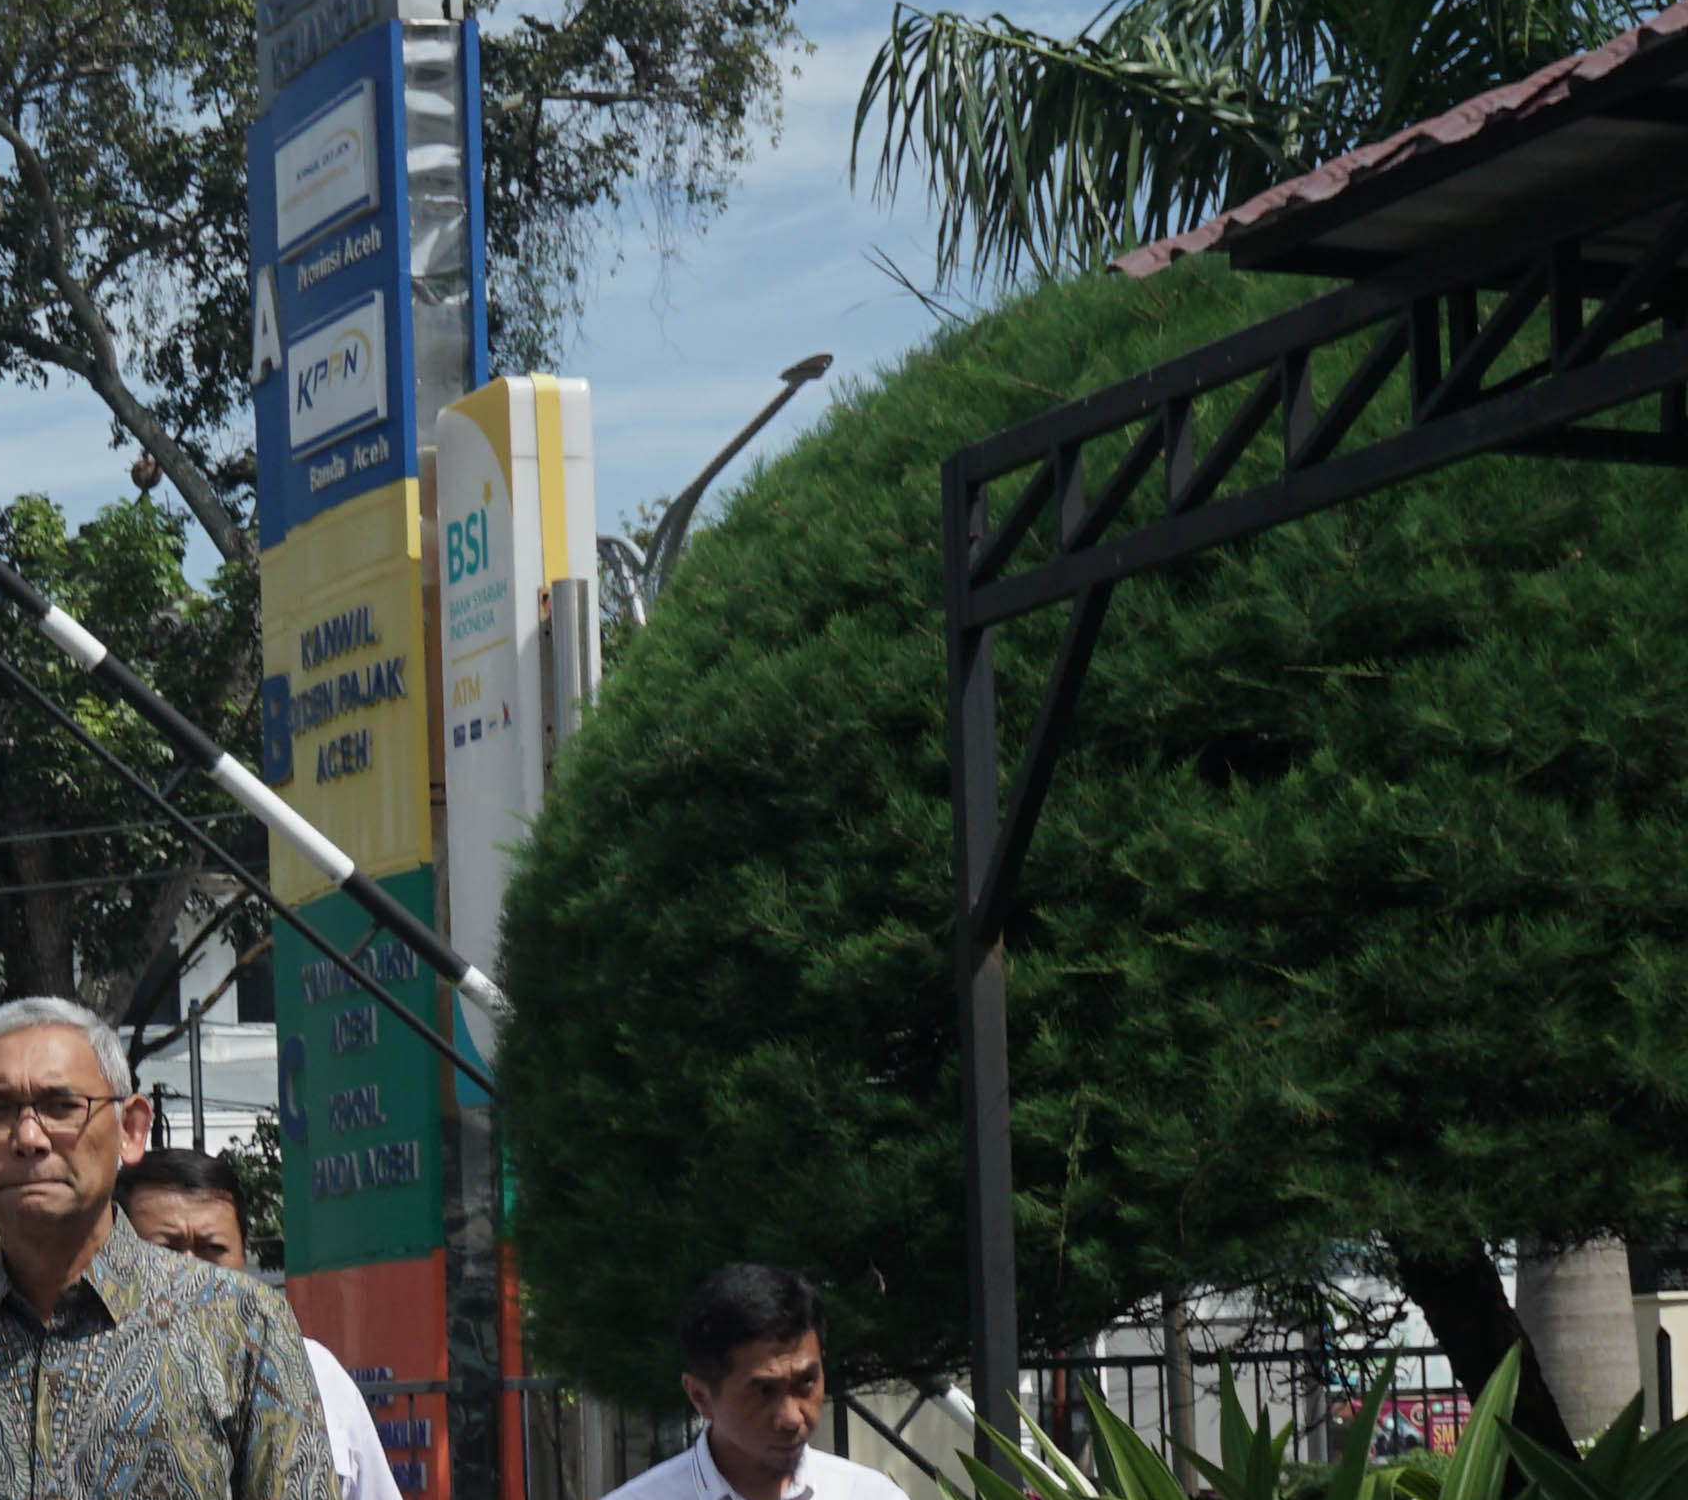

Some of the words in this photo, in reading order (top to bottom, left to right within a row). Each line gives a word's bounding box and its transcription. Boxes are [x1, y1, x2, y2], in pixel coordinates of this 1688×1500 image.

[344, 223, 382, 266] Aceh
[250, 263, 282, 386] A
[297, 343, 358, 415] KPPN
[309, 453, 347, 492] Banda
[352, 433, 389, 474] Aceh
[447, 508, 488, 586] BSI
[300, 604, 379, 672] KANWIL
[450, 599, 471, 621] BANK
[450, 608, 496, 642] INDONESIA
[338, 655, 407, 713] PAJAK
[452, 671, 481, 708] ATM
[260, 672, 293, 787] B
[316, 728, 372, 785] ACEH
[332, 1004, 378, 1052] ACEH
[279, 1032, 308, 1148] C
[365, 1140, 420, 1188] ACEH
